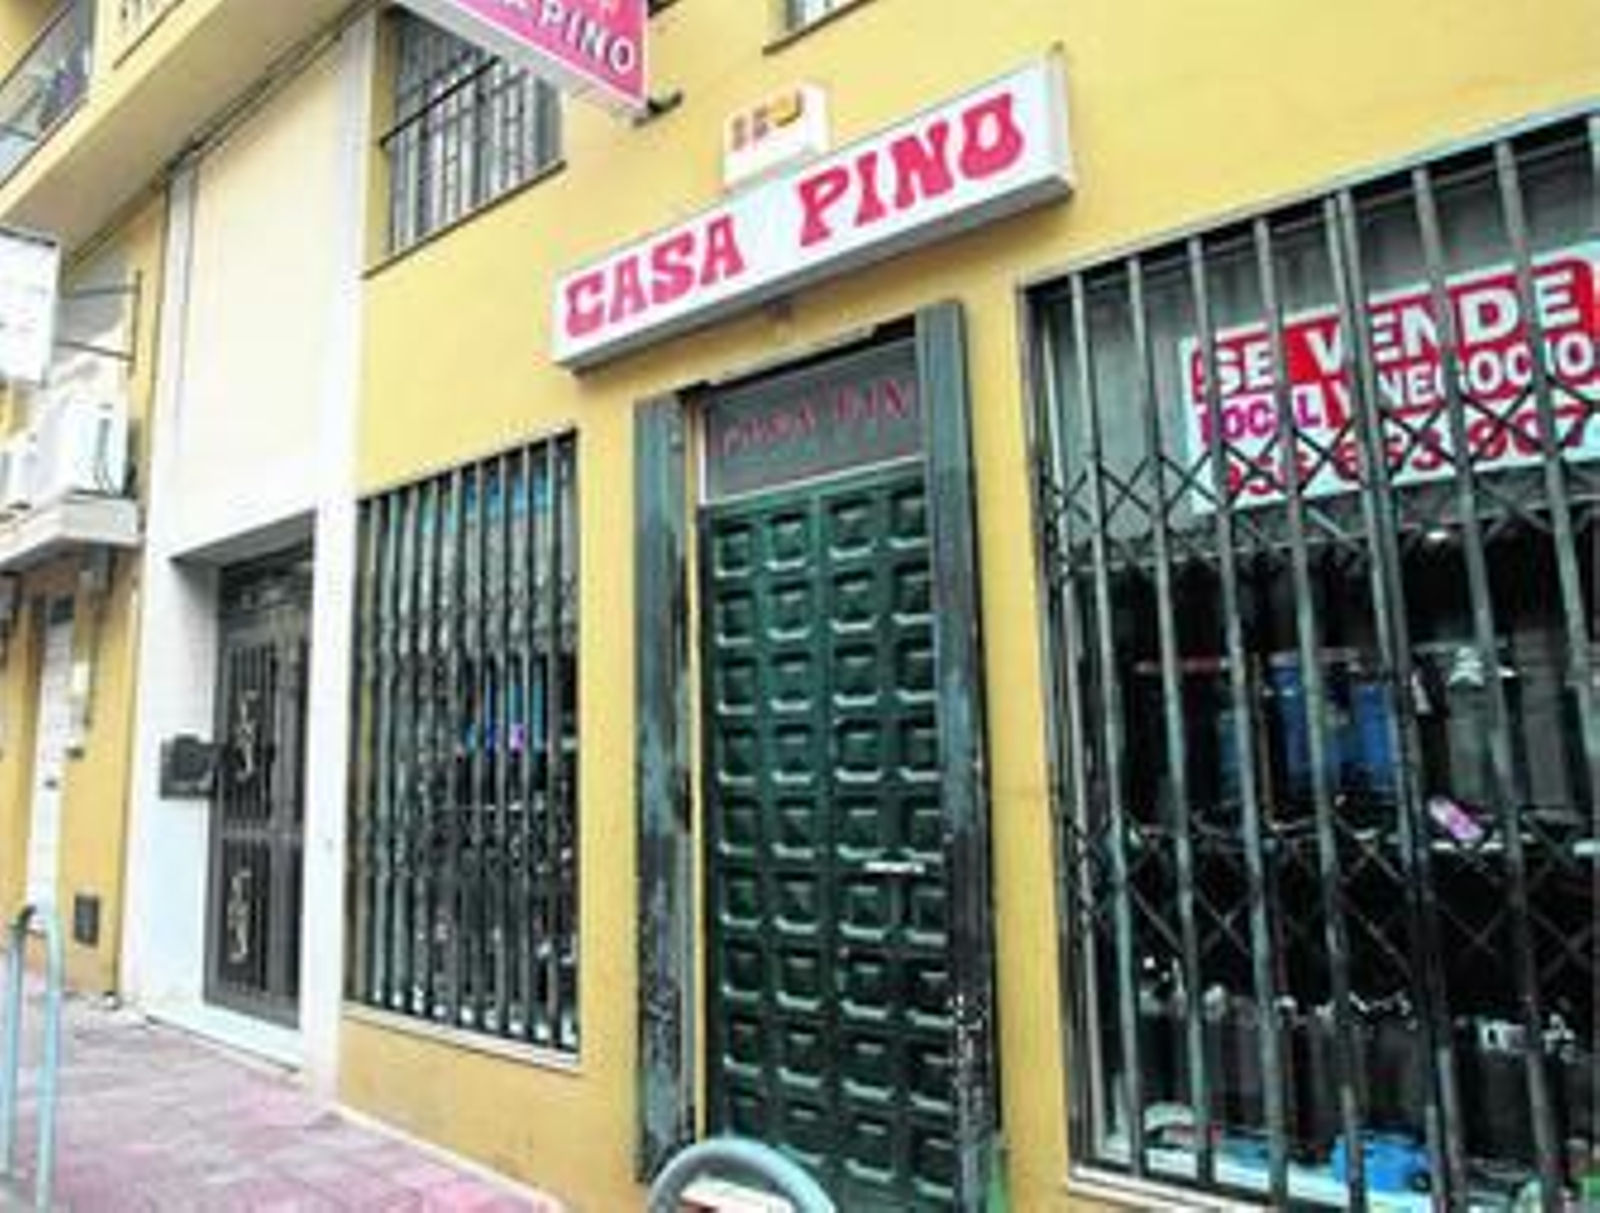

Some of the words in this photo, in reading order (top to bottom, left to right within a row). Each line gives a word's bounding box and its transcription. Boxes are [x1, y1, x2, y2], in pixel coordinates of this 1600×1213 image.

[537, 0, 635, 73] PINO
[564, 212, 746, 339] CASA
[797, 92, 1026, 247] PINO
[1194, 338, 1277, 398] SE
[1303, 268, 1582, 374] VENDE
[1199, 392, 1322, 447] LOCL
